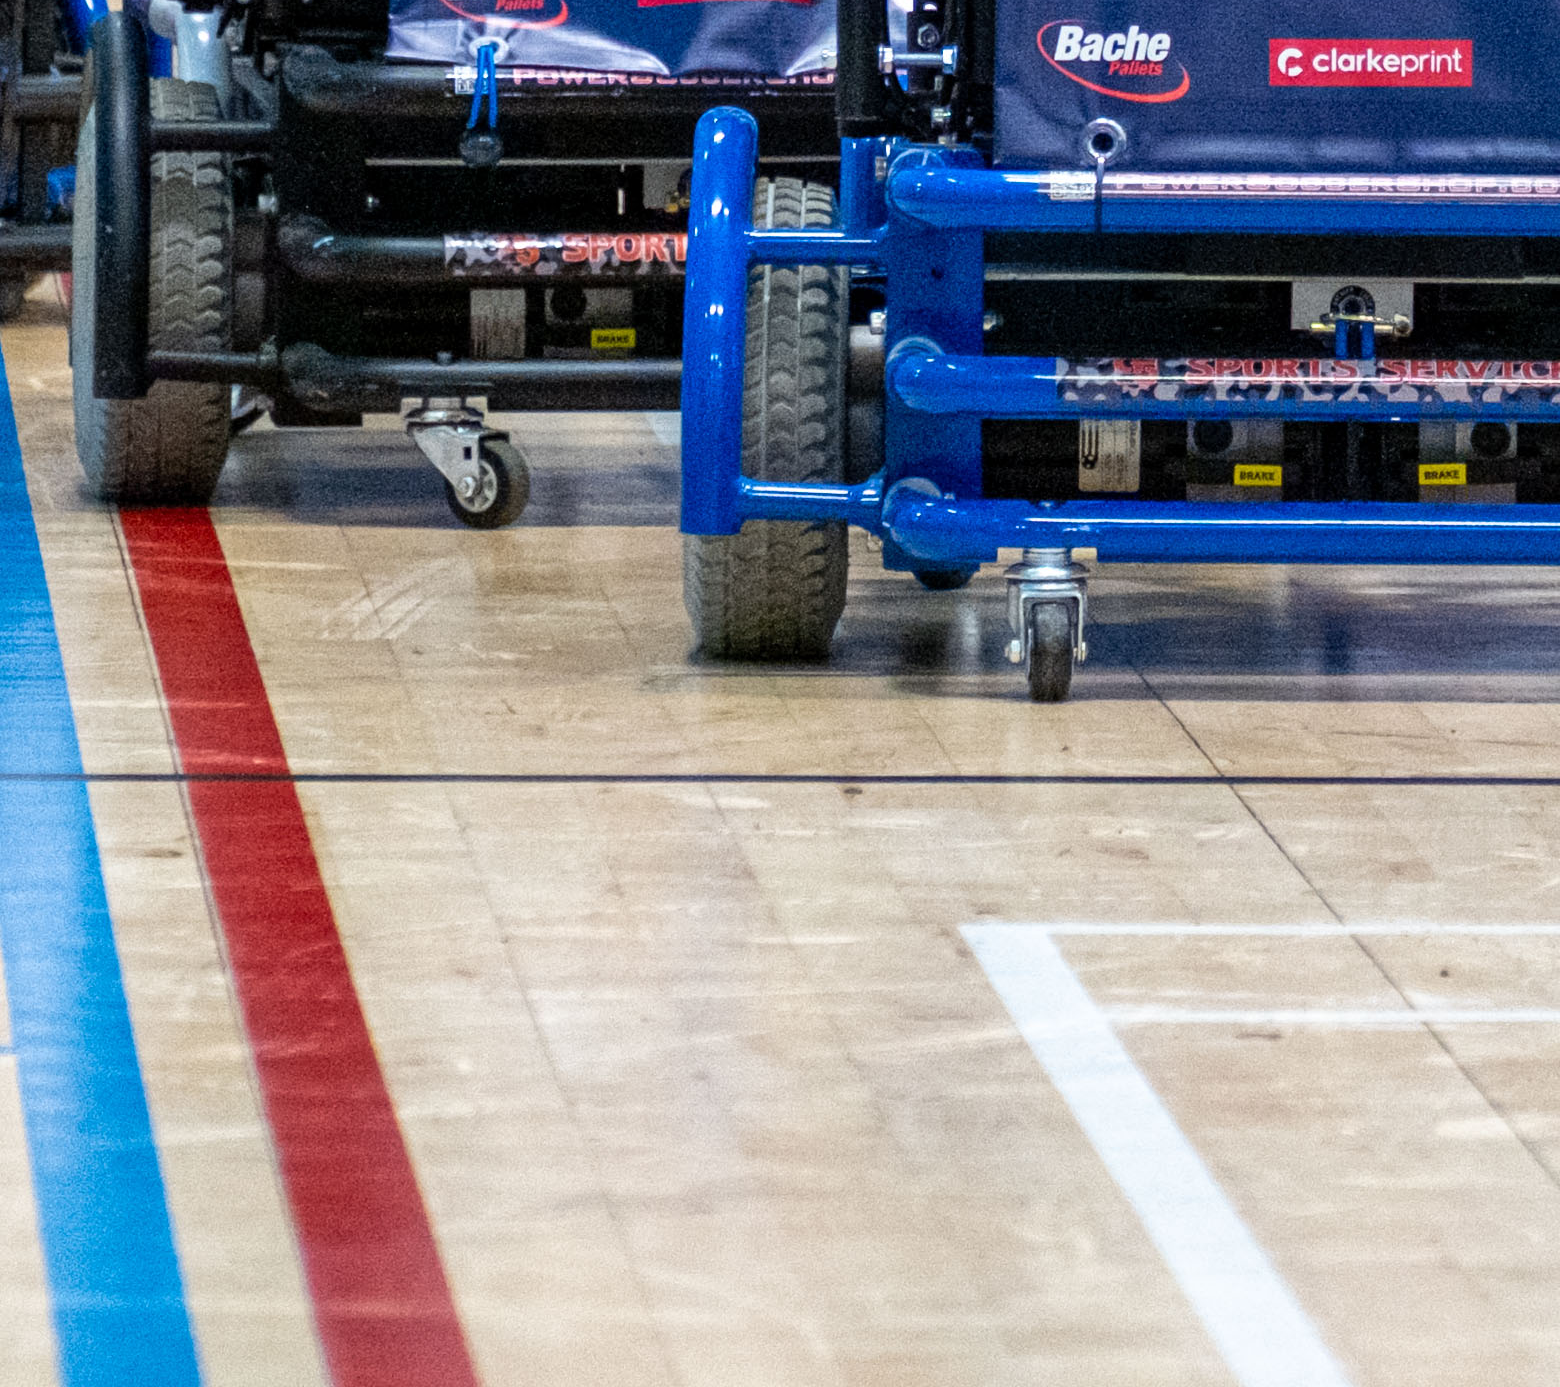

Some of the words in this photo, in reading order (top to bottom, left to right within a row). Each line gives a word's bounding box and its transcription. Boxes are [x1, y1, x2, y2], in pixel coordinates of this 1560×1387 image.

[1054, 25, 1171, 62] Bache
[1108, 60, 1164, 77] Pallets
[1312, 47, 1463, 78] clarkeprint
[1184, 358, 1360, 385] SPORTS
[1239, 469, 1276, 482] BRAKE
[1424, 468, 1461, 481] BRAKE
